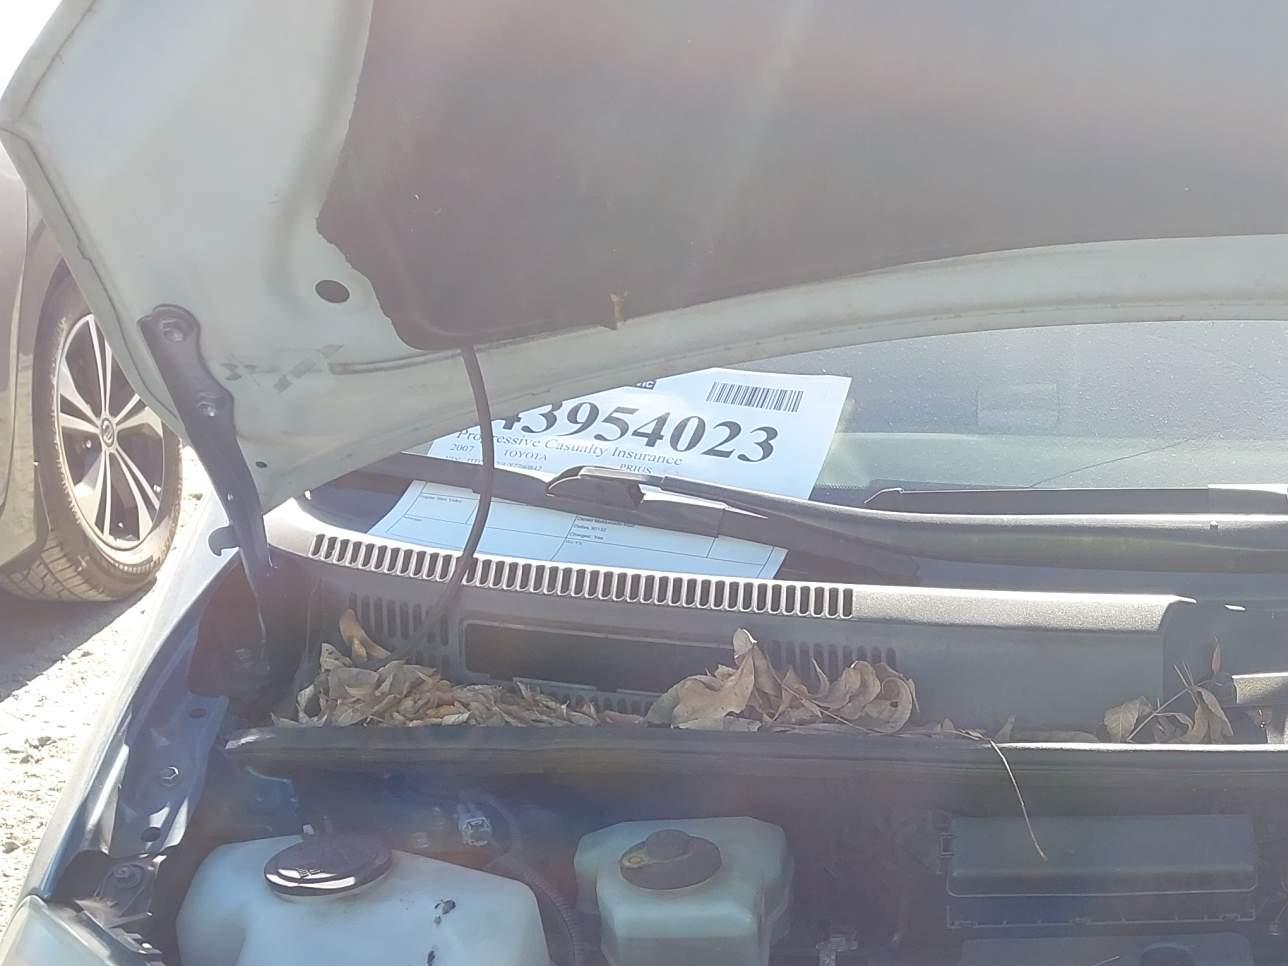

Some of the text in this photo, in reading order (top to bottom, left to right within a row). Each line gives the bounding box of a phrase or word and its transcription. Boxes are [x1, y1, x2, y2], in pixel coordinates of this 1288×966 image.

[449, 443, 653, 474] 2007 TOYOTA PRIUS
[456, 430, 684, 466] Proressive Casualty Insurance
